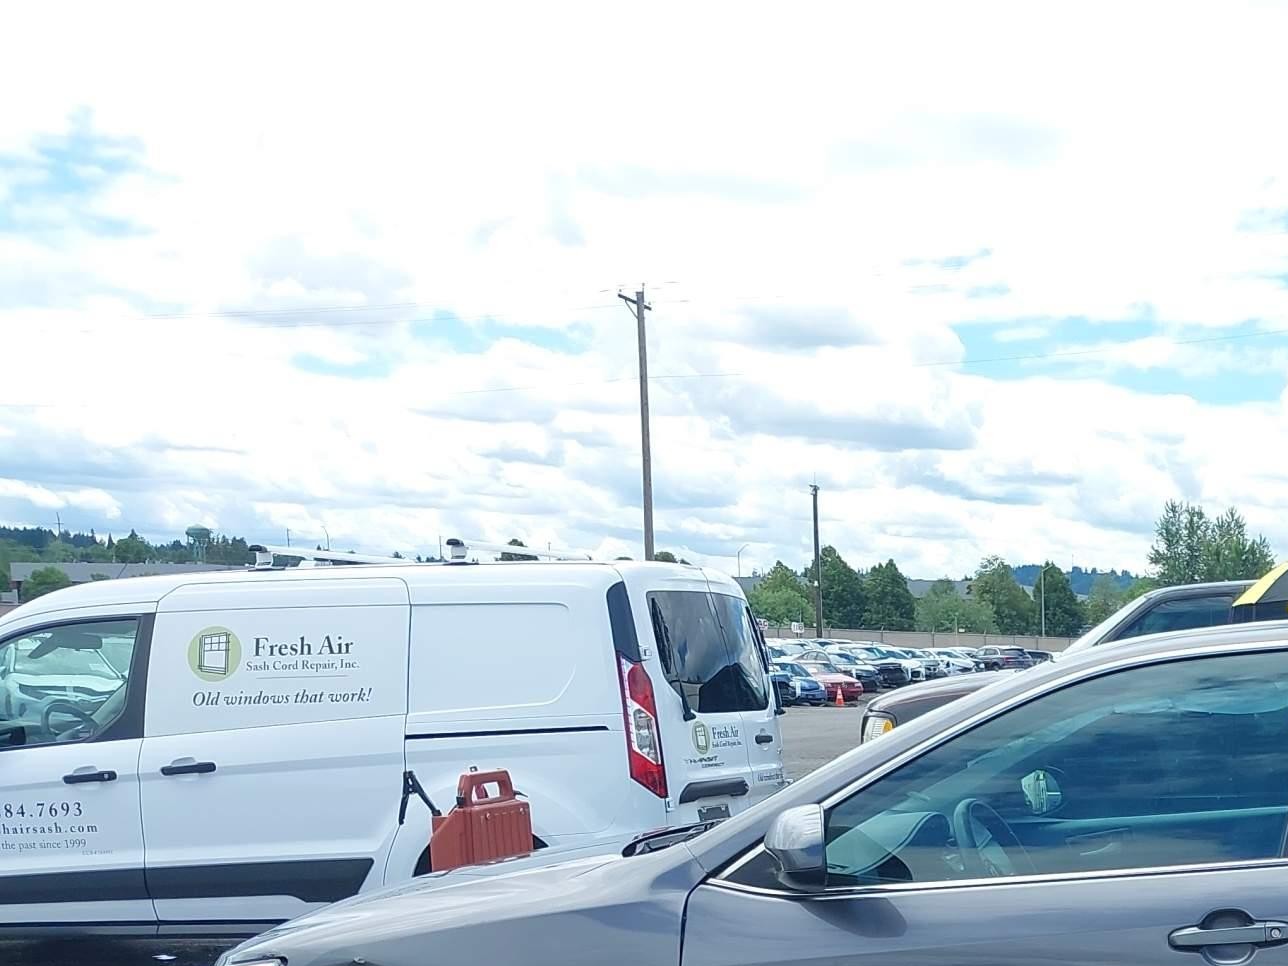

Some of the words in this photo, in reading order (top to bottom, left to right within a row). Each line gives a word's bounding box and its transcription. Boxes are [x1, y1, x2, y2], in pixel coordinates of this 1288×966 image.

[253, 635, 312, 657] Fresh
[317, 635, 354, 655] Air
[246, 661, 270, 672] Sash
[272, 659, 298, 671] Cord
[301, 659, 338, 673] Repair,
[340, 658, 360, 669] Inc.
[192, 691, 221, 707] Old
[223, 690, 290, 705] windows
[294, 689, 324, 704] that
[328, 687, 373, 703] work!
[711, 726, 729, 739] Fresh
[0, 802, 82, 818] 84.7693
[0, 822, 98, 835] hairsash.com
[1, 840, 16, 850] the
[19, 842, 36, 853] past
[39, 840, 61, 849] since
[64, 838, 87, 848] 1999
